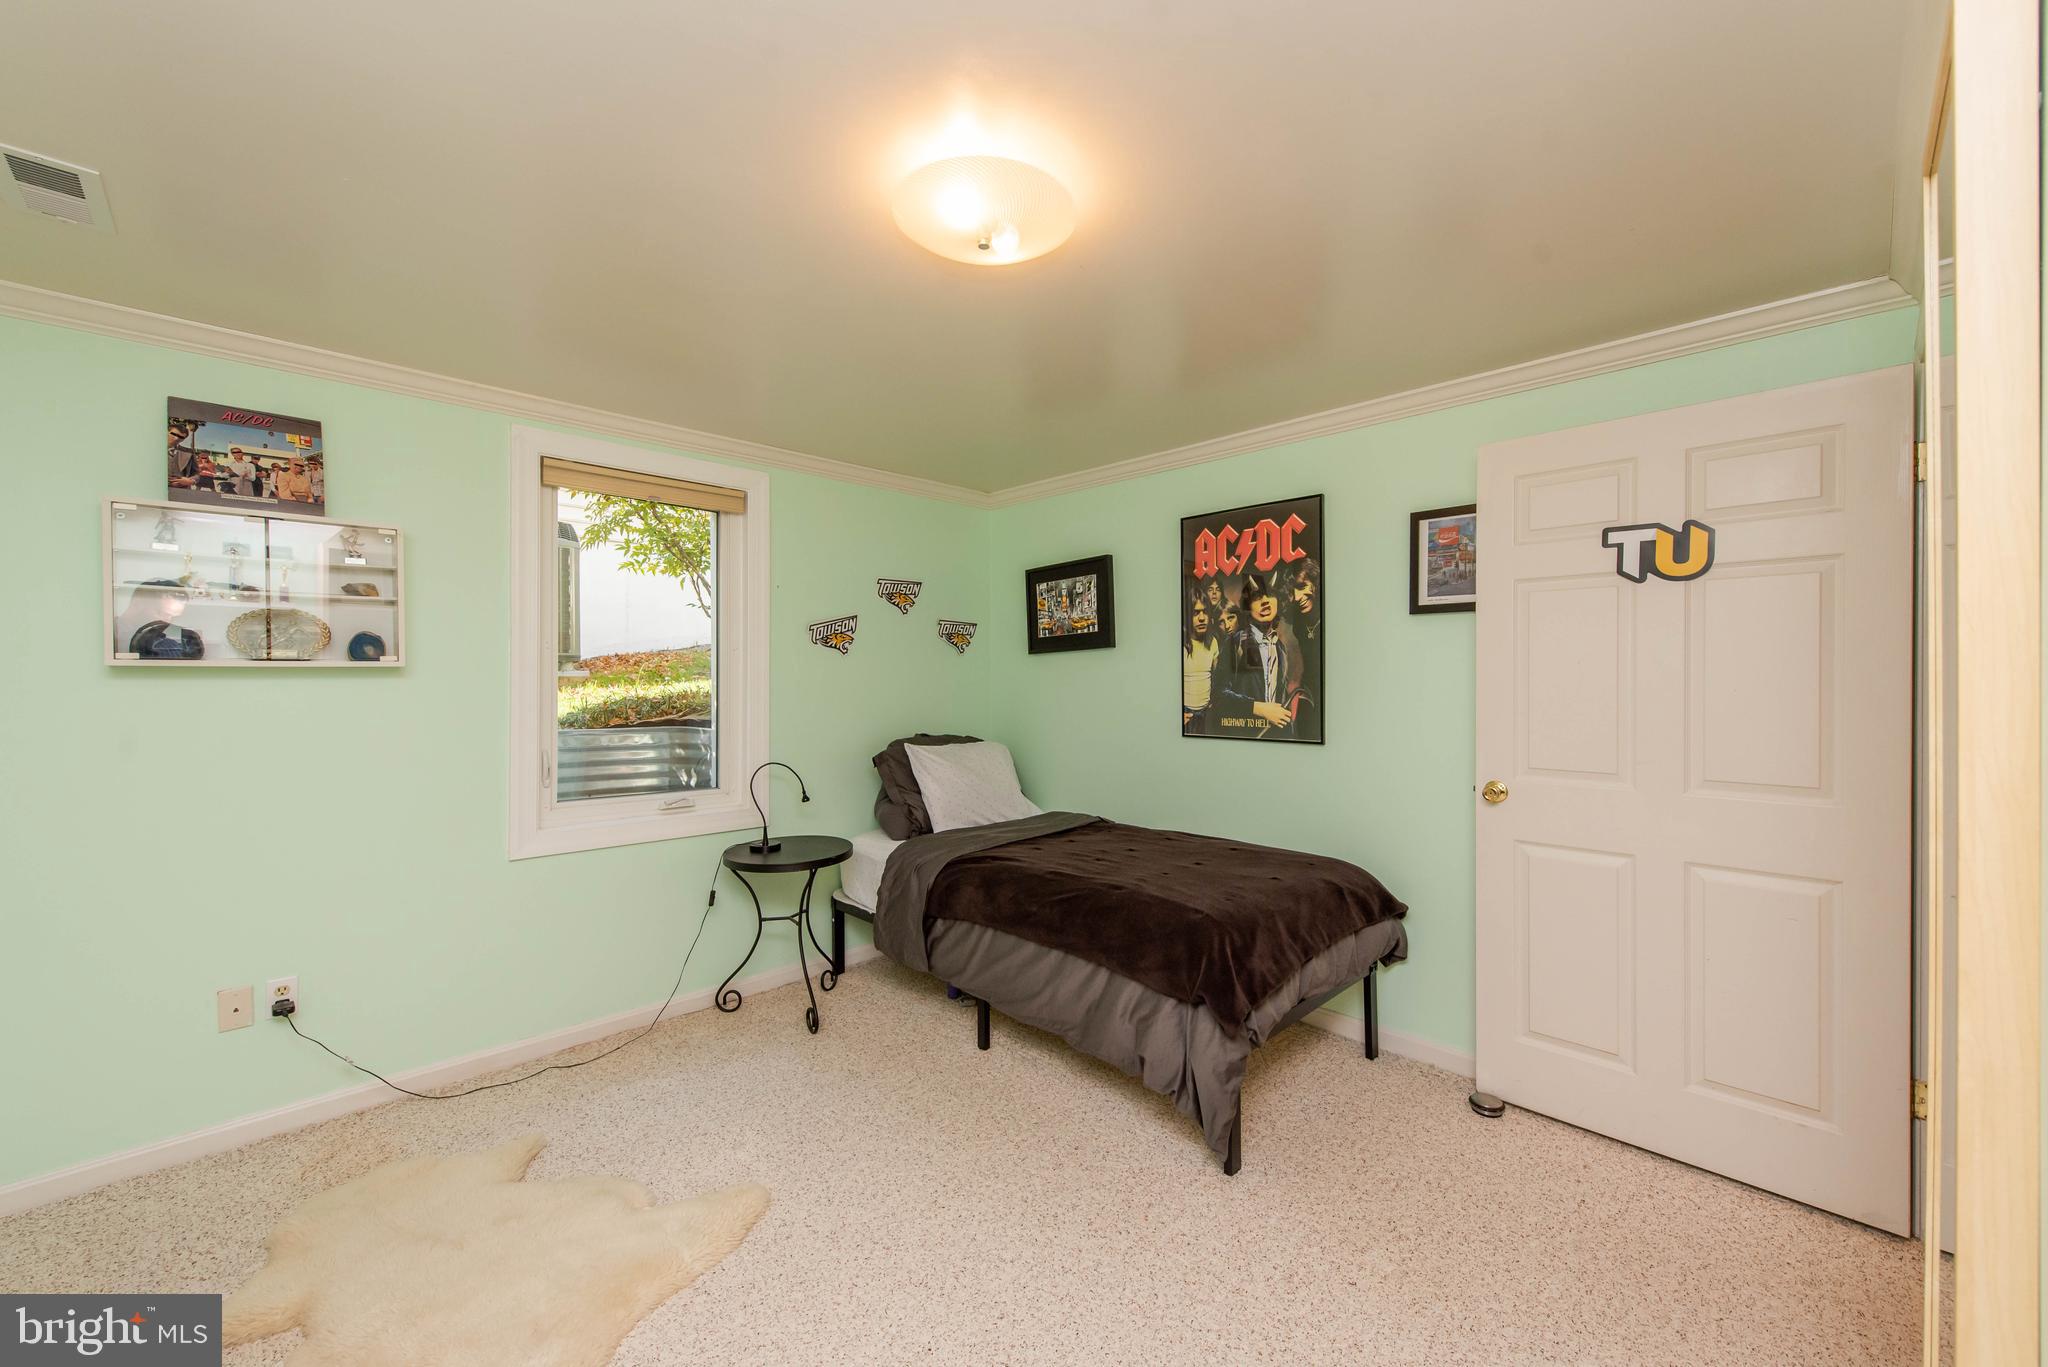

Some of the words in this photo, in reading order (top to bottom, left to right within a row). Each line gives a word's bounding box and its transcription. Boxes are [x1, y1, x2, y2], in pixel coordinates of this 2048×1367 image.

[221, 409, 274, 428] AC/DC
[1193, 513, 1307, 579] AC/DC
[1603, 520, 1715, 583] TU
[877, 579, 921, 598] TOWSON
[810, 616, 857, 643] TOWSON
[938, 620, 977, 638] TOWSON
[1221, 717, 1246, 728] HIGHWAY
[1247, 718, 1255, 728] TO
[1255, 718, 1270, 728] HELL
